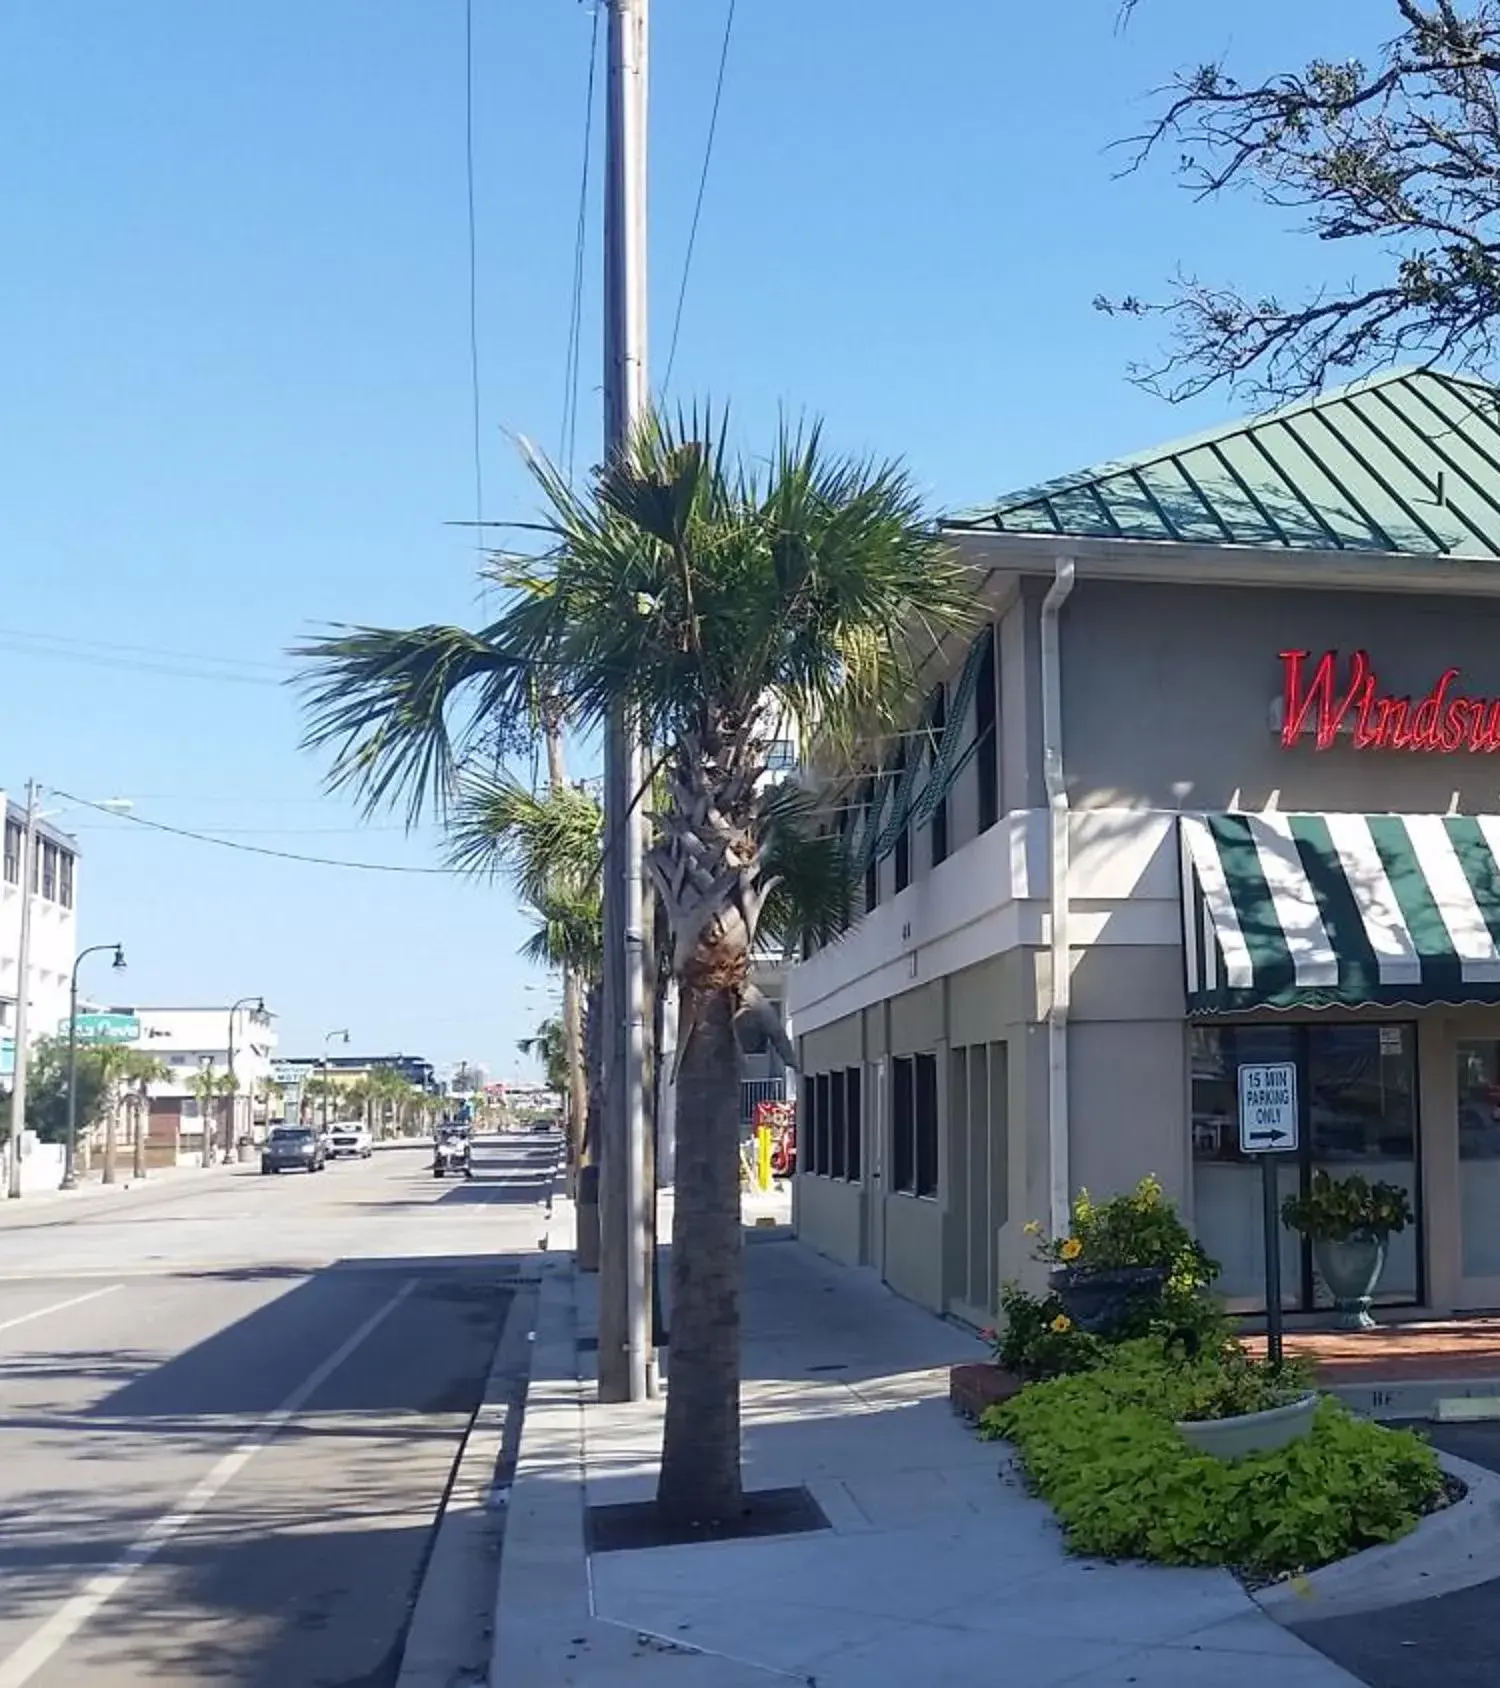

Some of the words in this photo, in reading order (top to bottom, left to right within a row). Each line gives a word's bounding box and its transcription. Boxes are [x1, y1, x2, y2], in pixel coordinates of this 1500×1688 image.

[1248, 1071, 1261, 1088] 15
[1265, 1070, 1287, 1087] MIN
[1247, 1089, 1289, 1106] PARKING
[1256, 1107, 1281, 1125] ONLY
